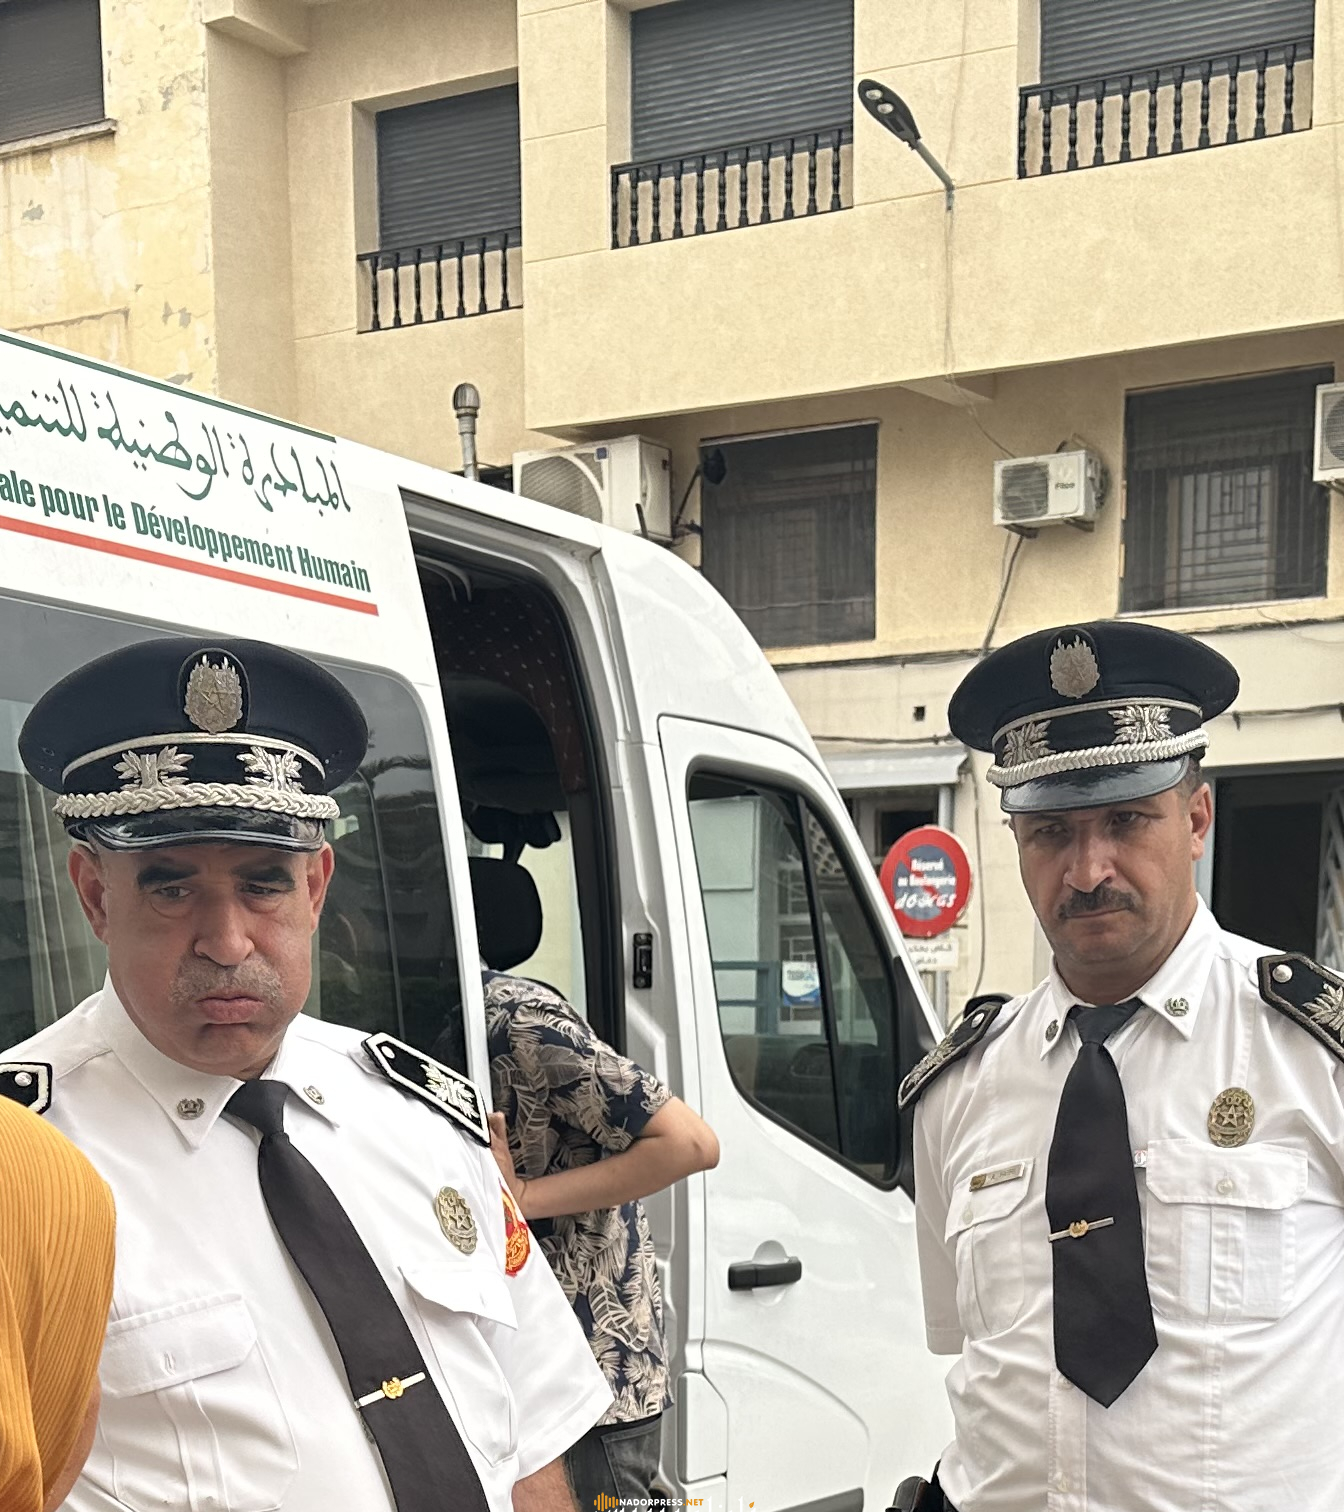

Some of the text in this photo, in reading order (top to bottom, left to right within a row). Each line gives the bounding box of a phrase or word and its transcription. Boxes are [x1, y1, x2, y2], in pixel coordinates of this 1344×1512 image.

[90, 389, 230, 501] الوطنية
[227, 433, 352, 517] المبادرة
[38, 483, 100, 524] pour
[102, 494, 127, 530] le
[130, 501, 297, 575] Développement
[296, 546, 371, 593] Humain
